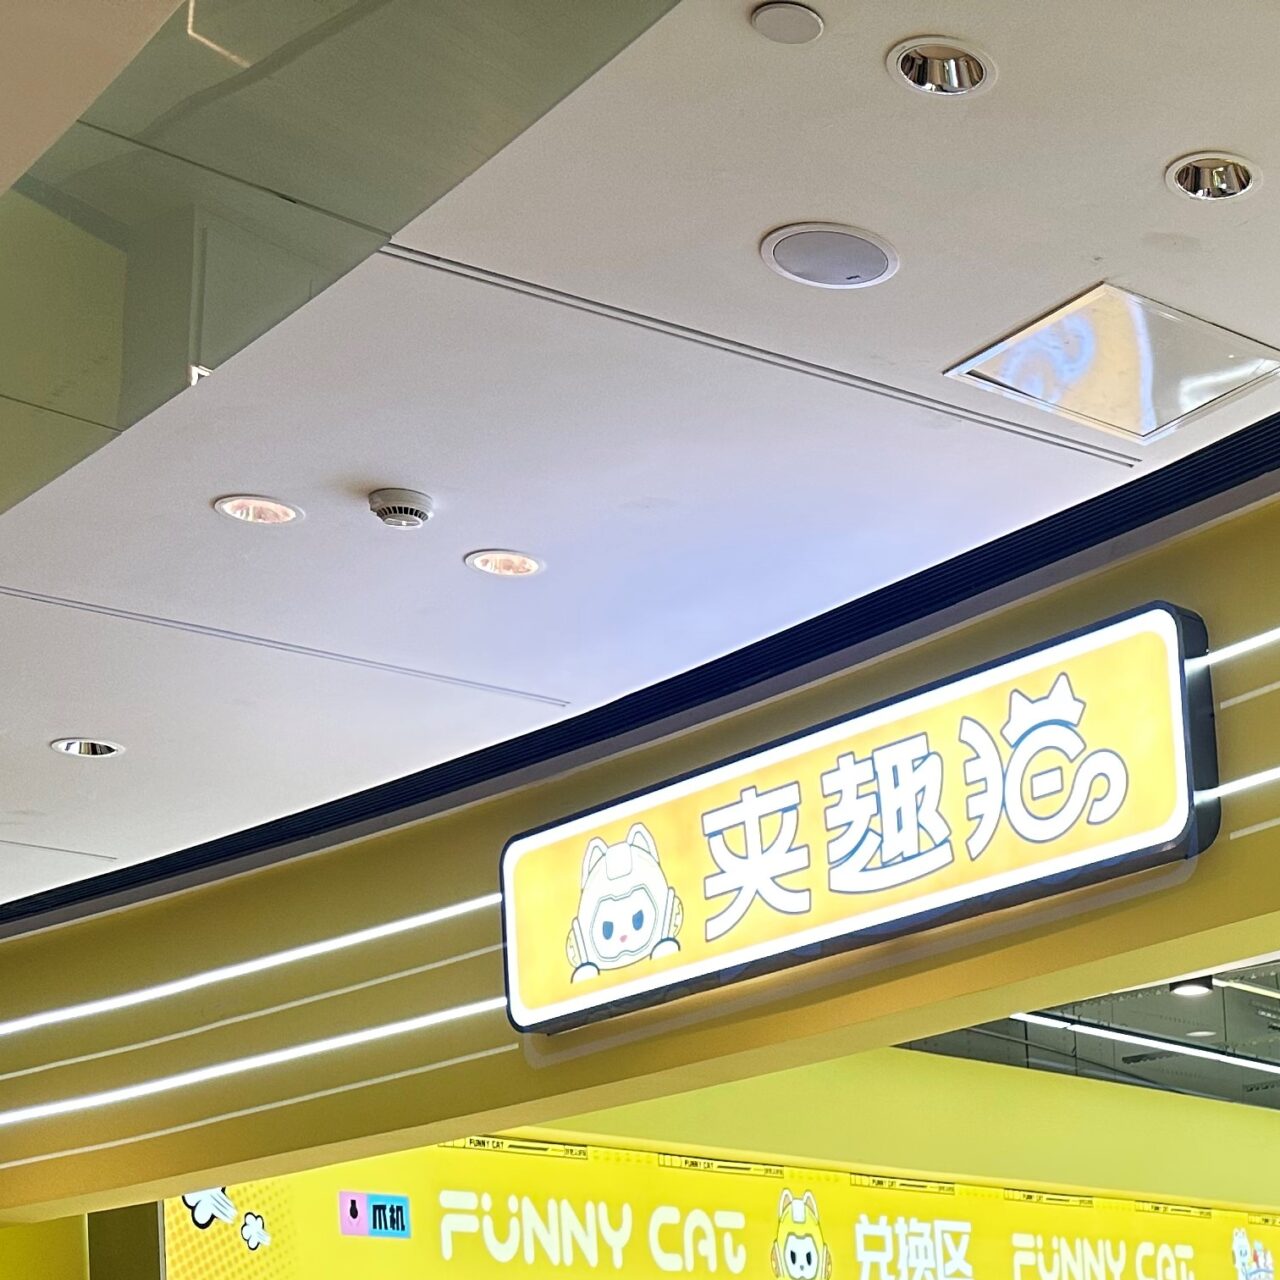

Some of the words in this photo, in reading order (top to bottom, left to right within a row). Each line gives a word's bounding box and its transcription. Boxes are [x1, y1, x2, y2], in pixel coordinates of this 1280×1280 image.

[701, 671, 1129, 942] 夹趣猫
[439, 1190, 632, 1270] FUNNY
[648, 1205, 747, 1275] CAT
